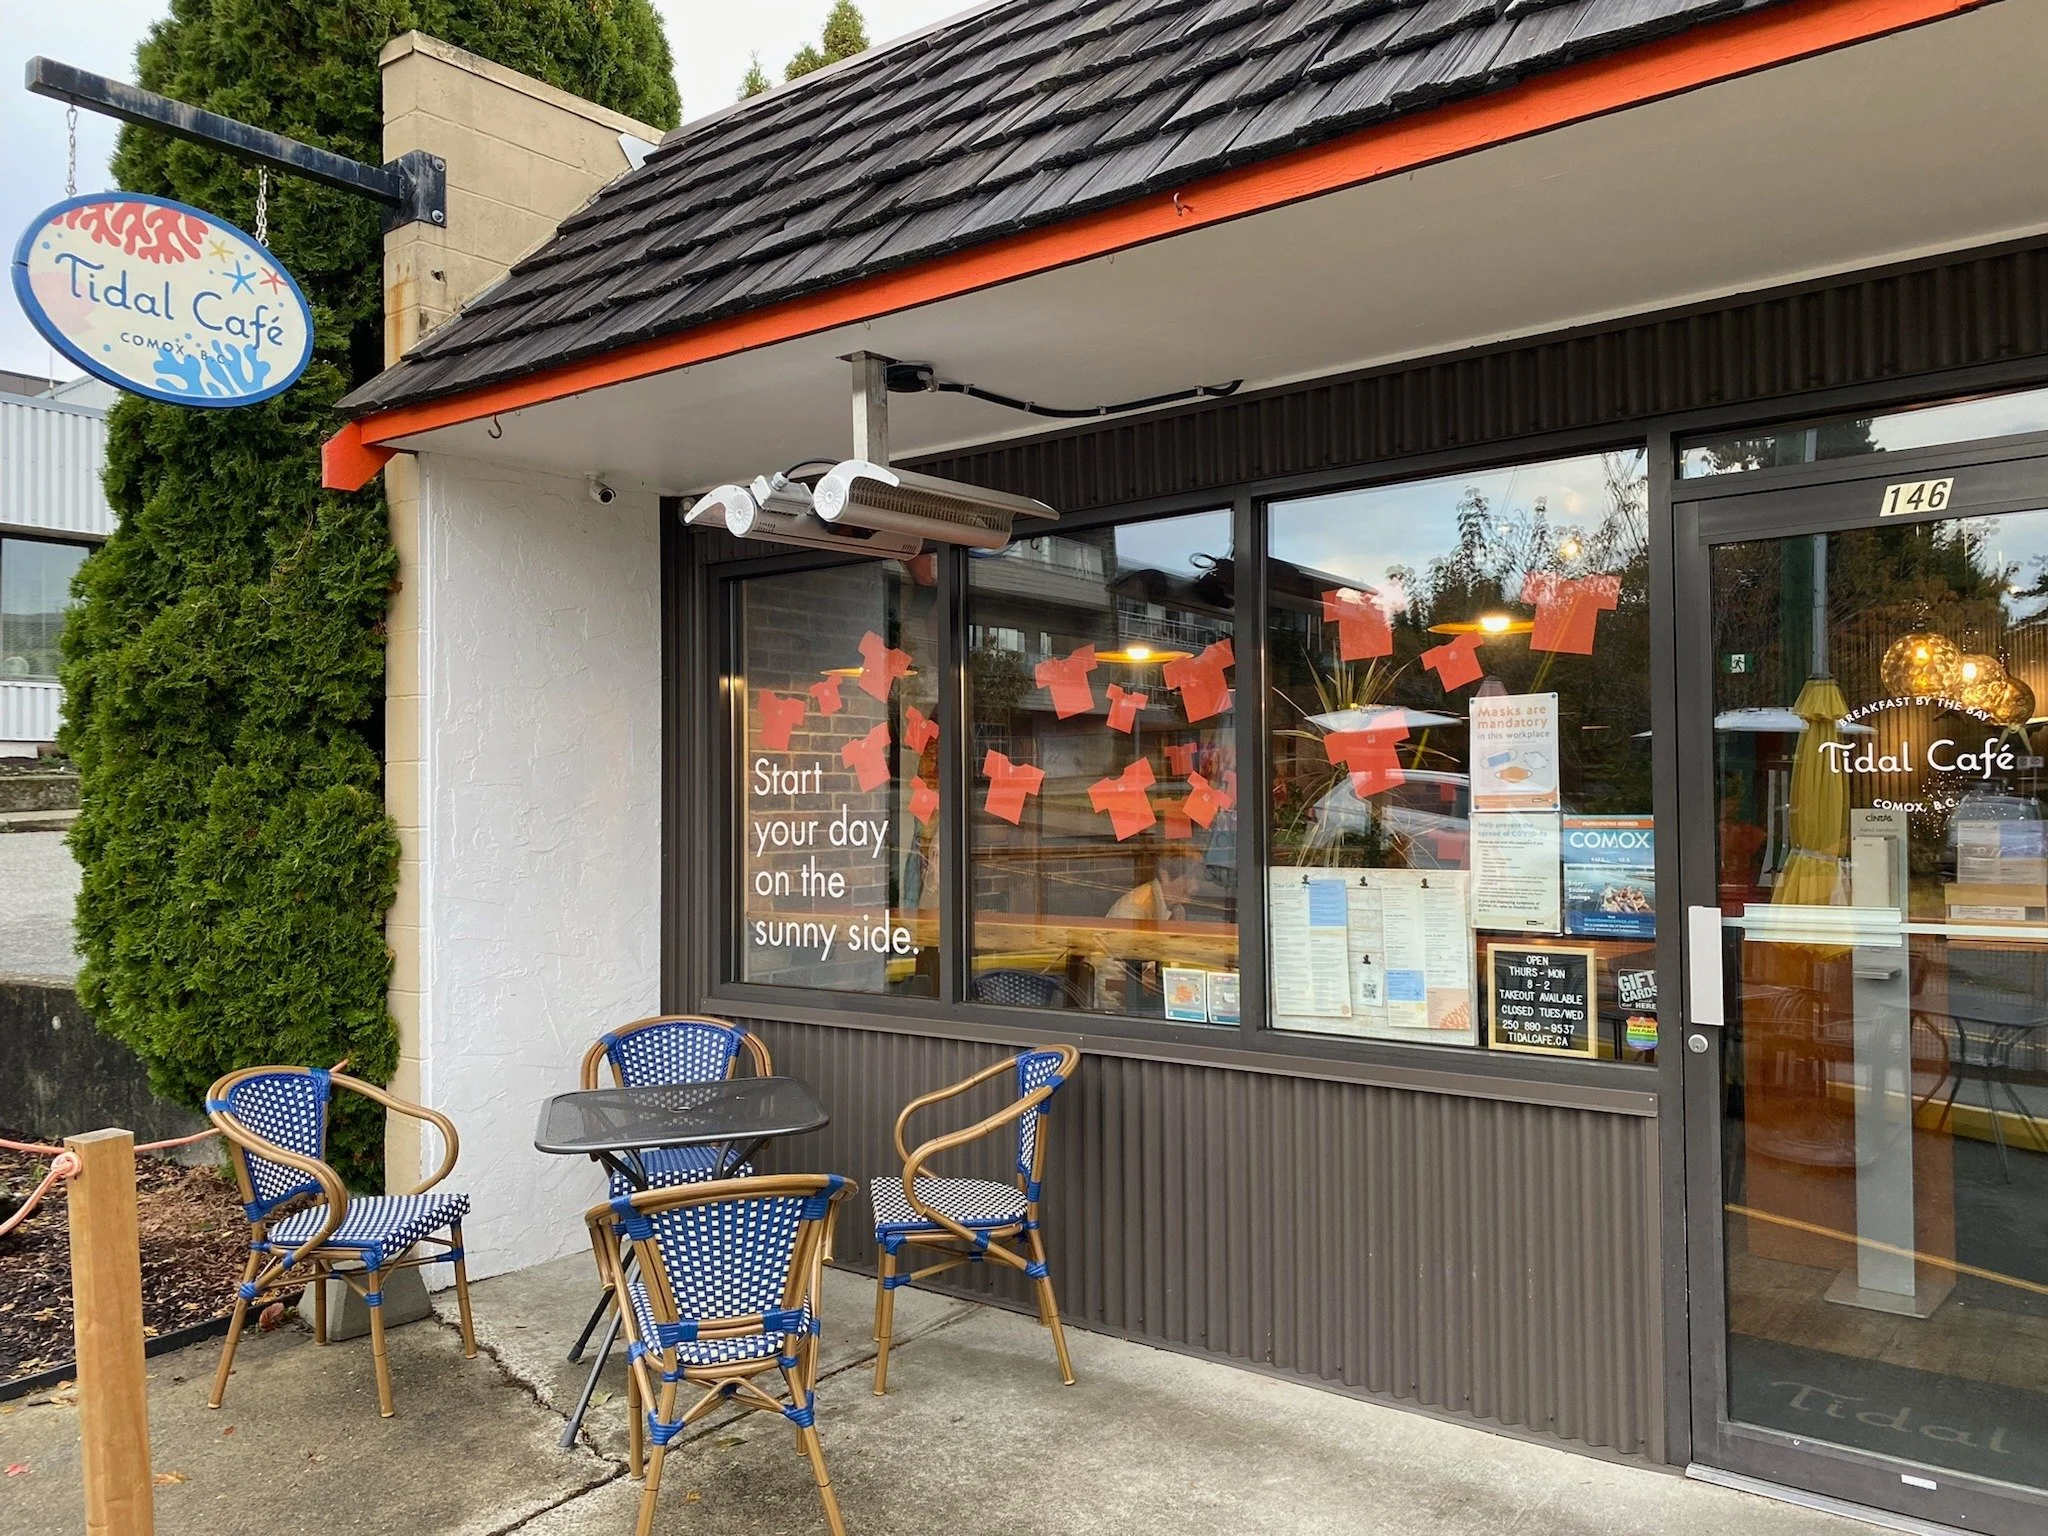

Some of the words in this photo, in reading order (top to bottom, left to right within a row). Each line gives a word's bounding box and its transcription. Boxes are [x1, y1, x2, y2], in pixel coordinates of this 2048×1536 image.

[55, 252, 175, 320] Tidal
[192, 291, 284, 351] Café
[1890, 481, 1948, 514] 146
[1477, 705, 1521, 717] Masks
[1526, 704, 1547, 716] are
[1837, 696, 1911, 727] BREAKFAST
[1915, 696, 1932, 706] BY
[1936, 697, 1963, 712] THE
[1965, 705, 1992, 722] BAY
[1477, 717, 1548, 730] mandatory
[1487, 731, 1503, 740] this
[1506, 729, 1551, 741] workplace
[1818, 740, 1913, 774] Tidal
[1927, 737, 2015, 780] Café
[754, 757, 823, 796] Start
[1872, 798, 1928, 813] COMOX,
[1933, 797, 1960, 812] B.C.
[754, 819, 819, 858] your
[828, 803, 889, 859] day
[1569, 831, 1651, 849] COMOX
[755, 870, 790, 896] on
[800, 855, 845, 898] the
[755, 920, 837, 962] sunny
[848, 909, 920, 955] side.
[1526, 955, 1549, 966] OPEN
[1509, 966, 1538, 978] THURS
[1547, 969, 1566, 979] MON
[1619, 970, 1656, 992] GIFT
[1527, 979, 1533, 989] 8
[1544, 980, 1550, 990] 2
[1499, 989, 1536, 1001] TAKEOUT
[1539, 992, 1583, 1005] AVAILABLE
[1621, 985, 1658, 1003] CARDS
[1501, 1004, 1534, 1017] CLOSED
[1539, 1007, 1584, 1021] TUES/WED
[1635, 1002, 1657, 1010] HERE
[1502, 1019, 1519, 1030] 250
[1508, 1032, 1569, 1047] TIDALCAFE.CA
[1771, 1381, 2011, 1454] Tidal
